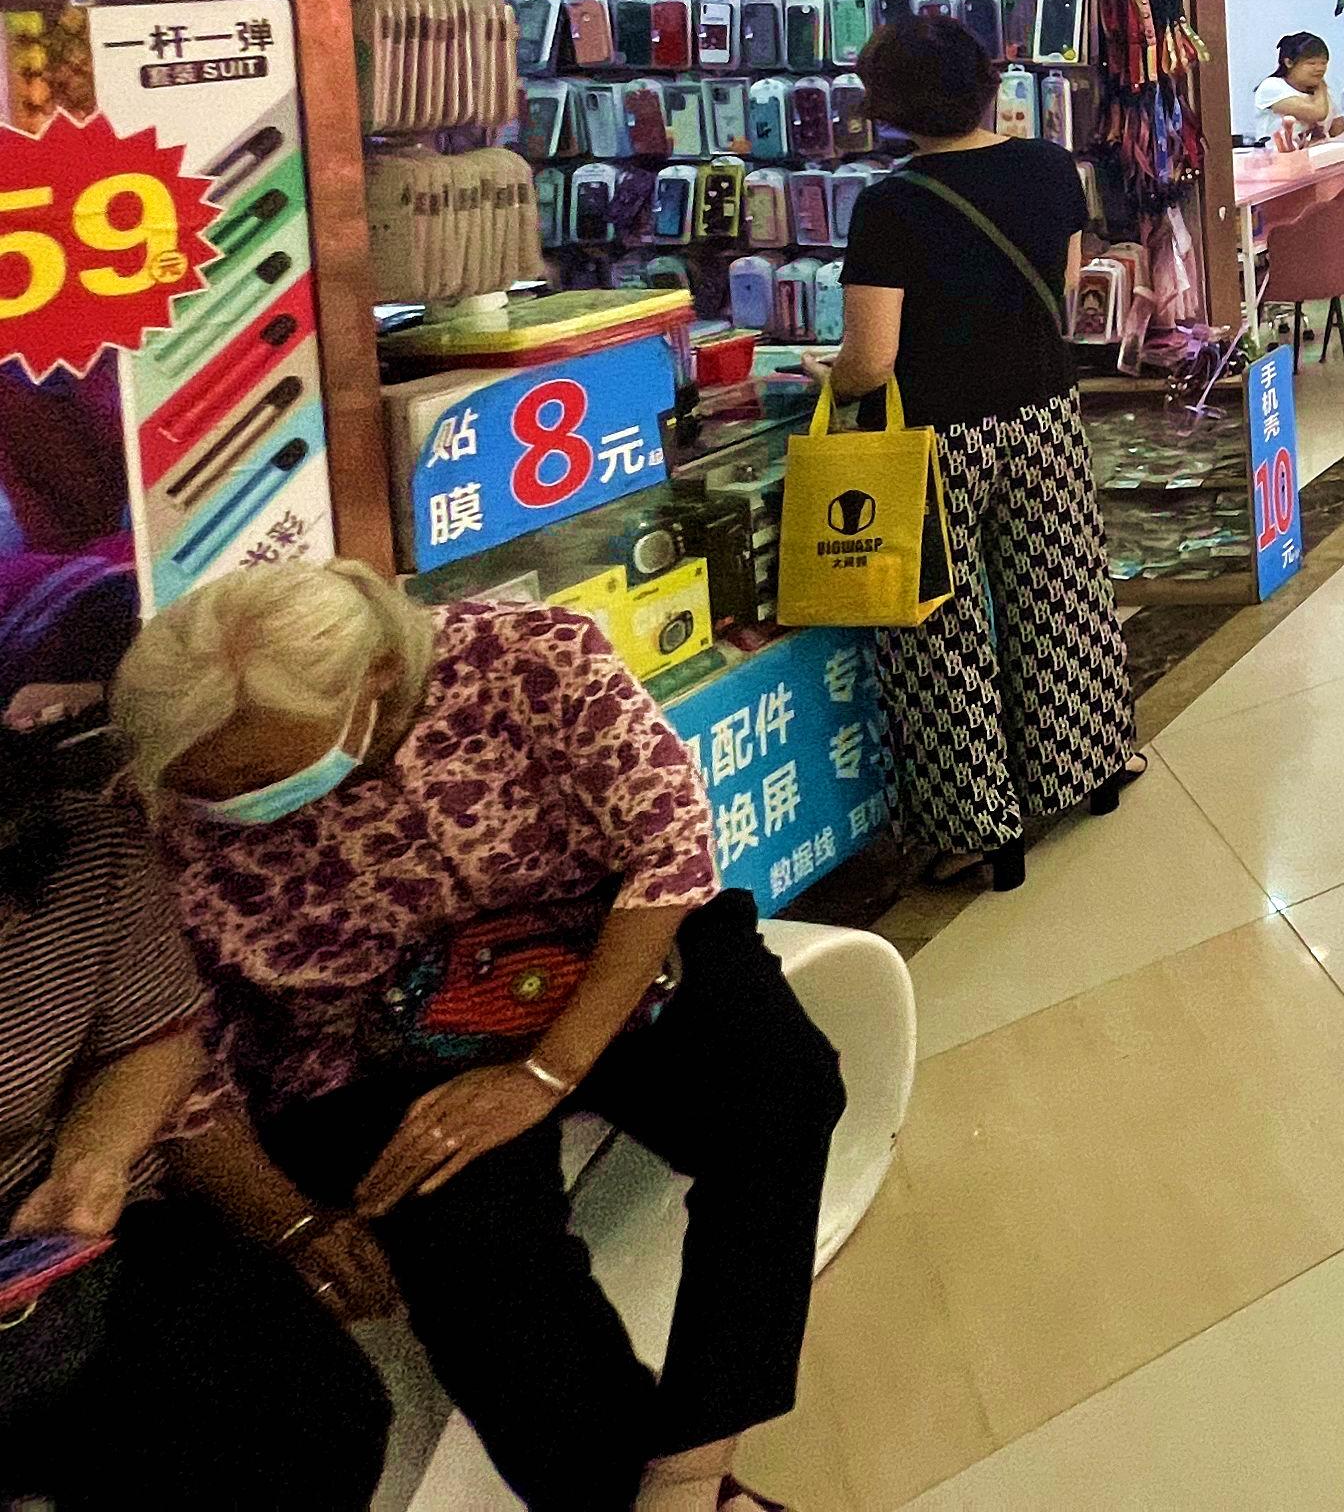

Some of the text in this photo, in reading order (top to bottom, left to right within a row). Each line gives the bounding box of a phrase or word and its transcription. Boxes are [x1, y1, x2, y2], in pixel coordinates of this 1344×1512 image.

[103, 17, 275, 60] 一杆一弹
[203, 58, 257, 80] SUIT
[1260, 360, 1281, 443] 手机壳
[510, 378, 594, 509] 8
[1254, 446, 1295, 553] 10
